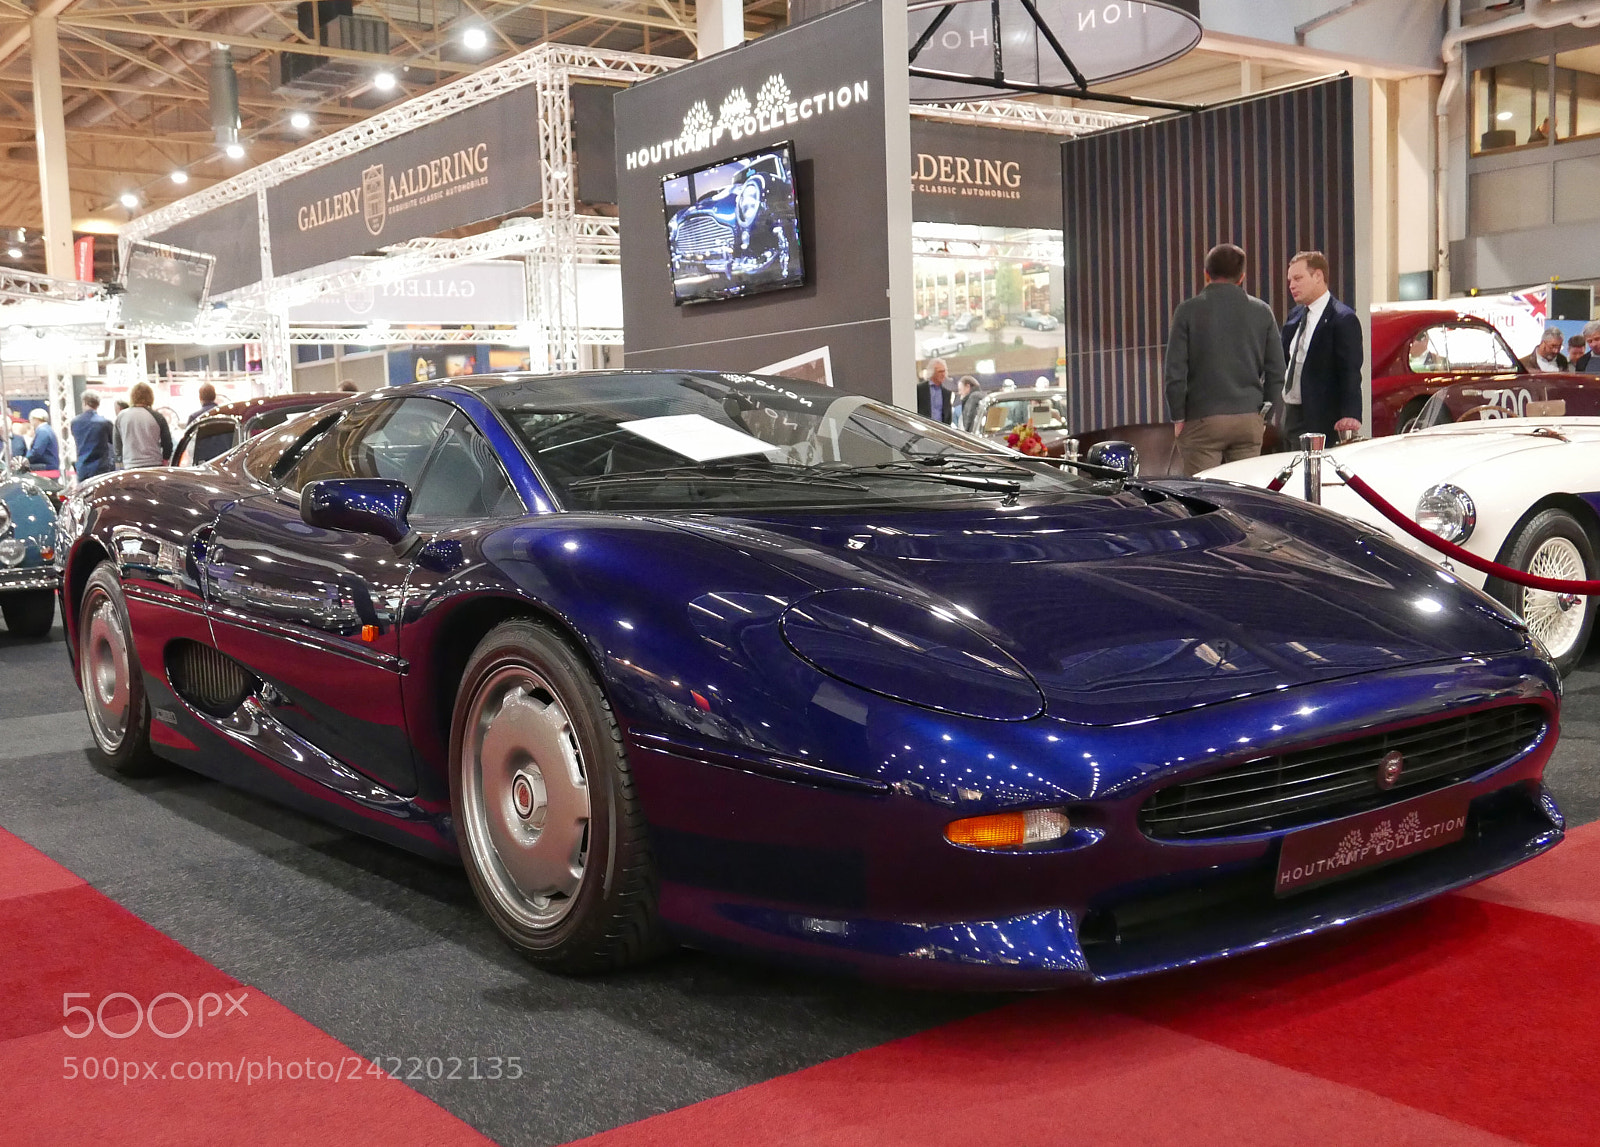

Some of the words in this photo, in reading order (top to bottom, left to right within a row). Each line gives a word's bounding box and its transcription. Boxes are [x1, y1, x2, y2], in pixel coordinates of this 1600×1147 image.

[627, 125, 725, 170] HOUTKAMP
[731, 80, 869, 140] COLLECTION
[298, 187, 361, 231] GALLERY
[387, 143, 489, 203] AALDERING
[419, 190, 444, 206] CLASSIC
[445, 176, 489, 197] AUTOMOBILES
[919, 184, 957, 195] CLASSIC
[961, 187, 1021, 199] AUTOMOBILES
[1280, 848, 1369, 885] HOUTKAMP
[1376, 815, 1465, 856] COLLECTION
